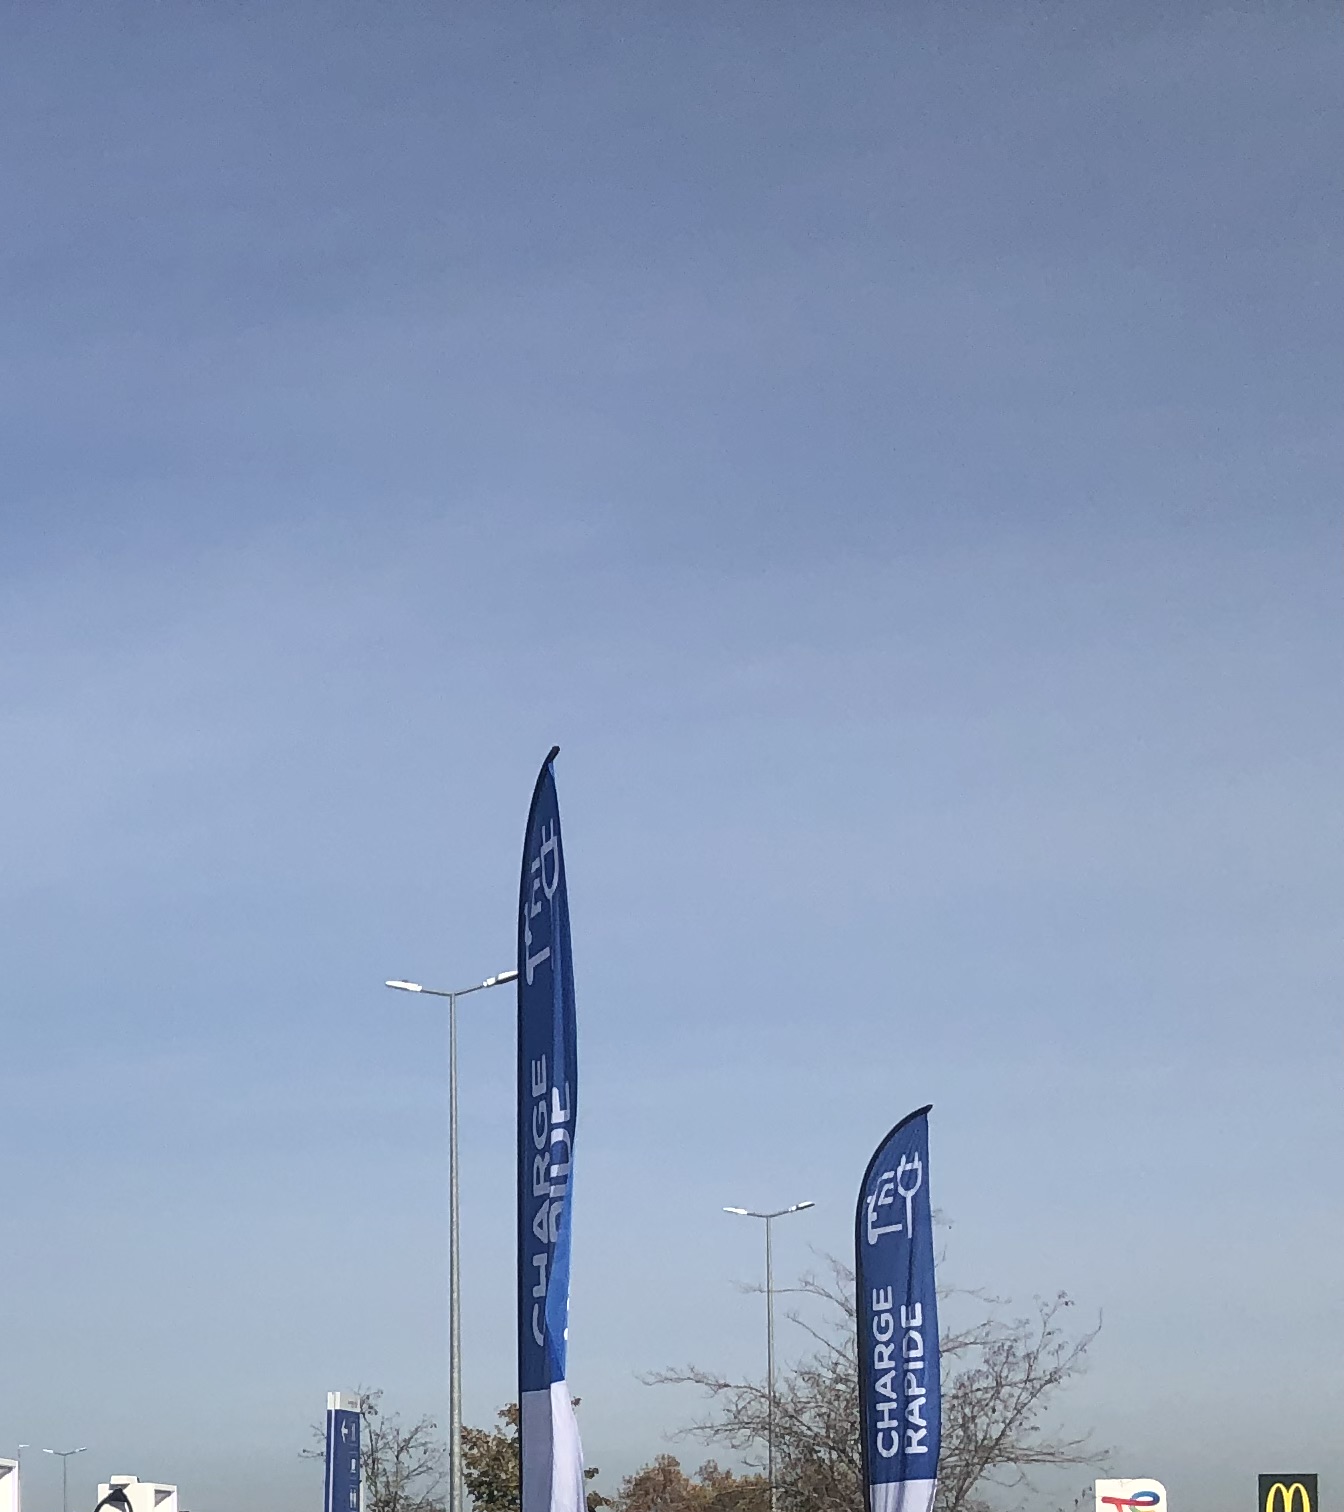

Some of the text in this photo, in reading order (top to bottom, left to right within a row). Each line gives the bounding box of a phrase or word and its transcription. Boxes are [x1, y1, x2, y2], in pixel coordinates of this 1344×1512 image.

[531, 1054, 551, 1346] CHARGE
[872, 1285, 899, 1458] CHARGE
[900, 1302, 929, 1454] RAPIDE
